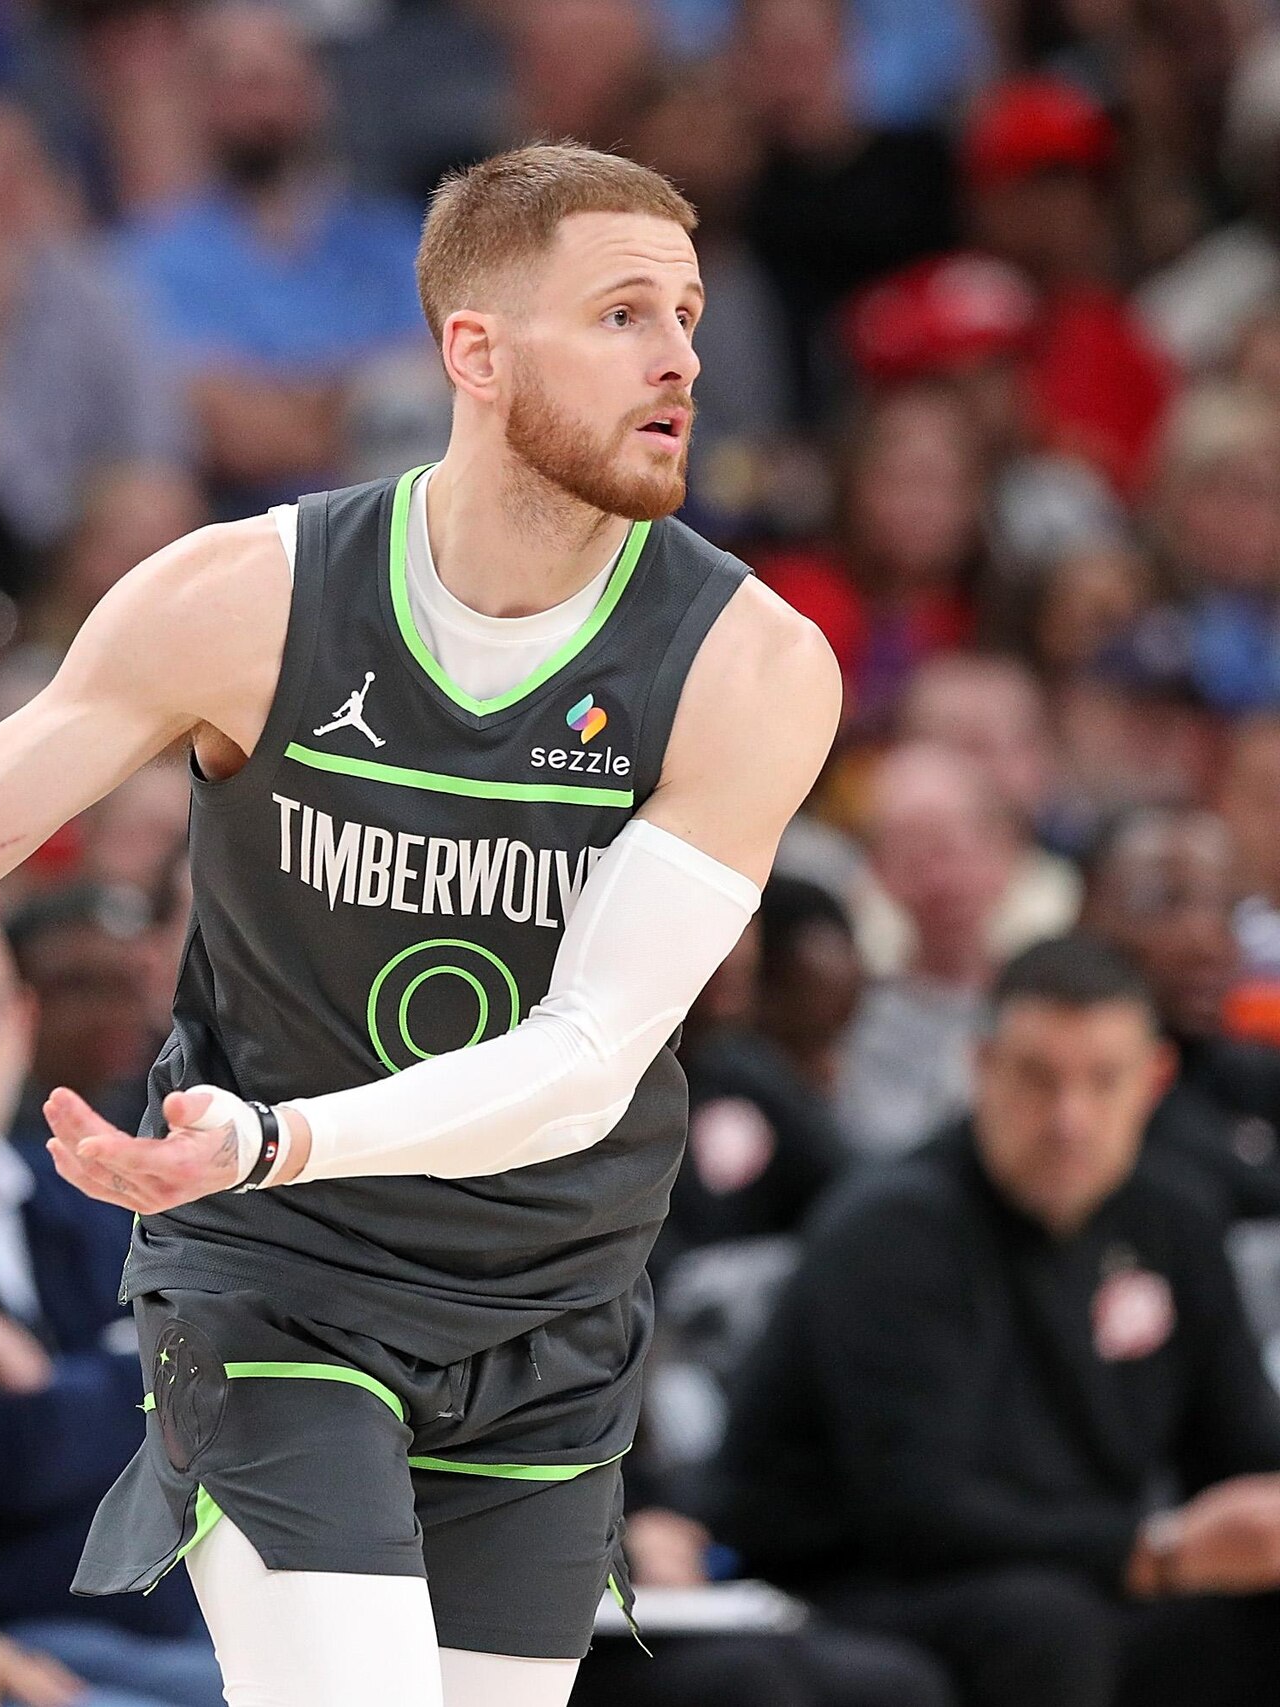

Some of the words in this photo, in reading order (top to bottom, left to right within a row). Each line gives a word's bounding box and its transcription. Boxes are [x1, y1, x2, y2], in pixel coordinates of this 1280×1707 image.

[530, 746, 631, 776] sezzle
[272, 792, 610, 929] TIMBERWOLV
[367, 938, 520, 1074] 0
